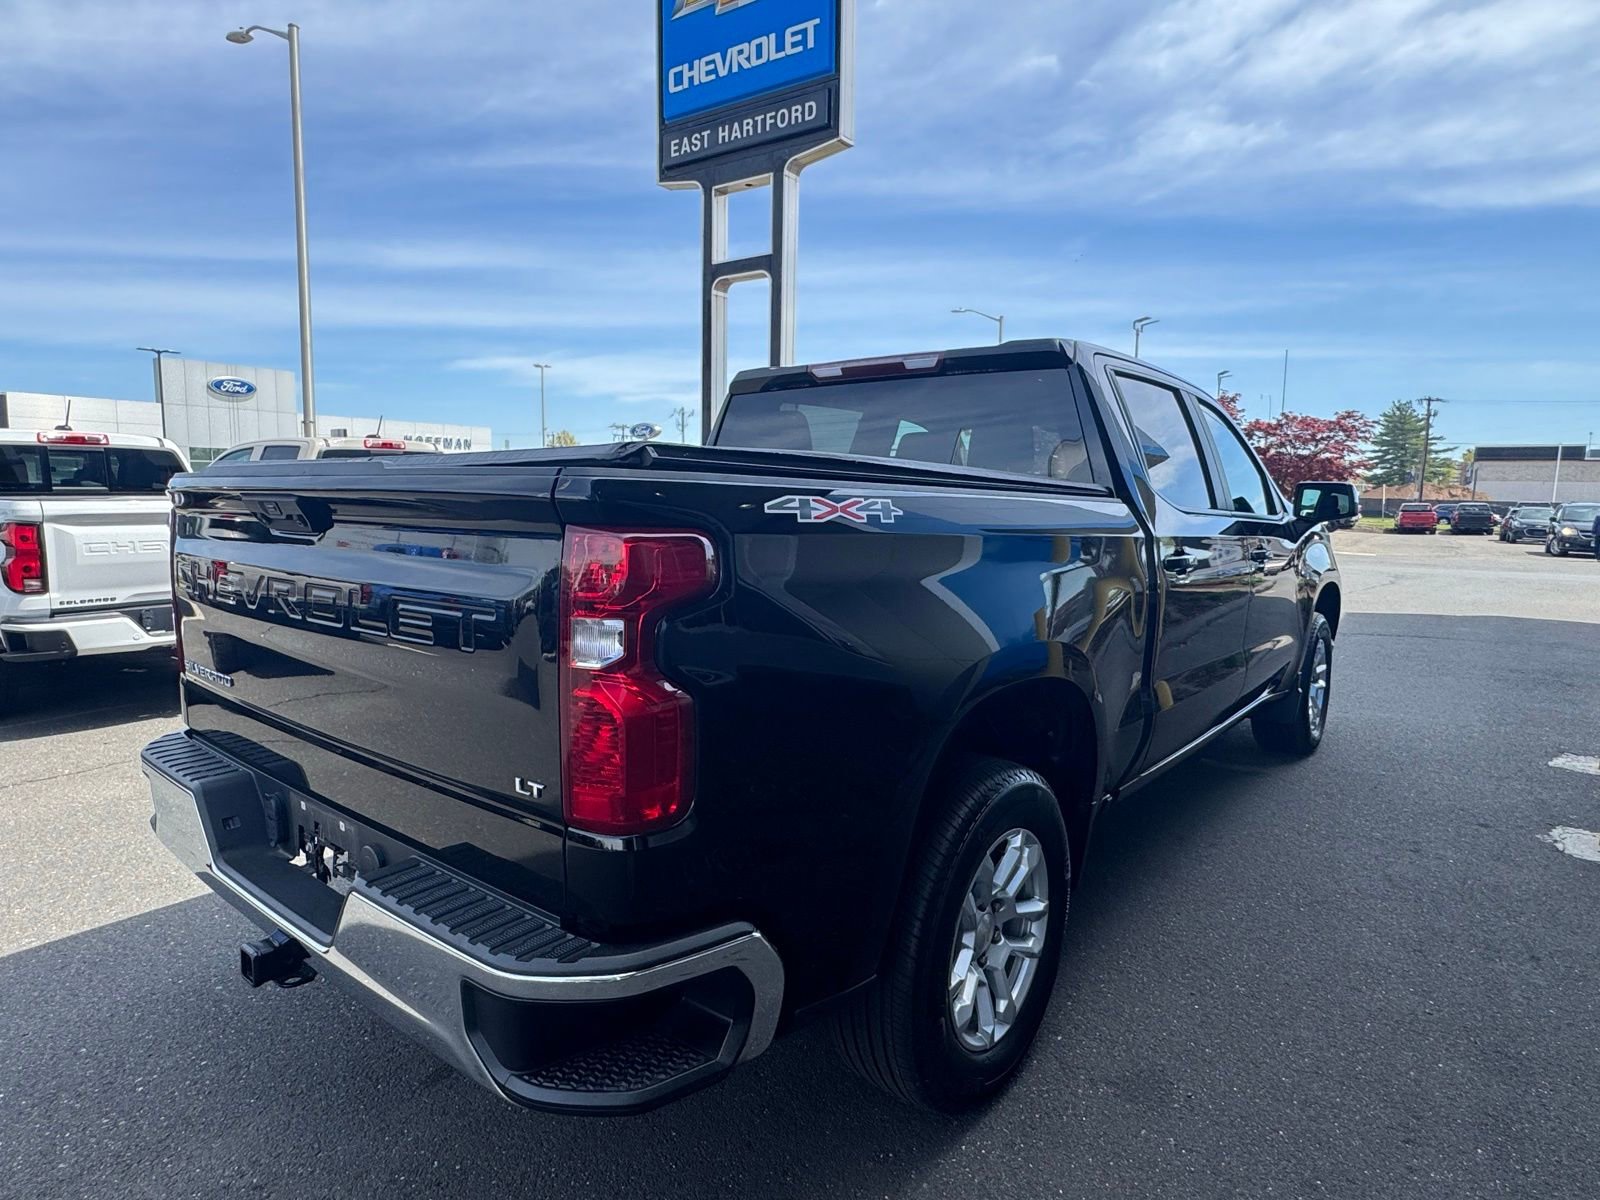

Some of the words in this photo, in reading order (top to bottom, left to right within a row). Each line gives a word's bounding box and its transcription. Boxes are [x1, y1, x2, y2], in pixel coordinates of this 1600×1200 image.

[668, 18, 820, 94] CHEVROLET
[670, 130, 710, 158] EAST
[718, 101, 816, 145] HARTFORD
[220, 380, 248, 393] Ford
[59, 597, 117, 606] COLORADO
[185, 660, 232, 687] SILVERADO
[514, 776, 546, 799] LT
